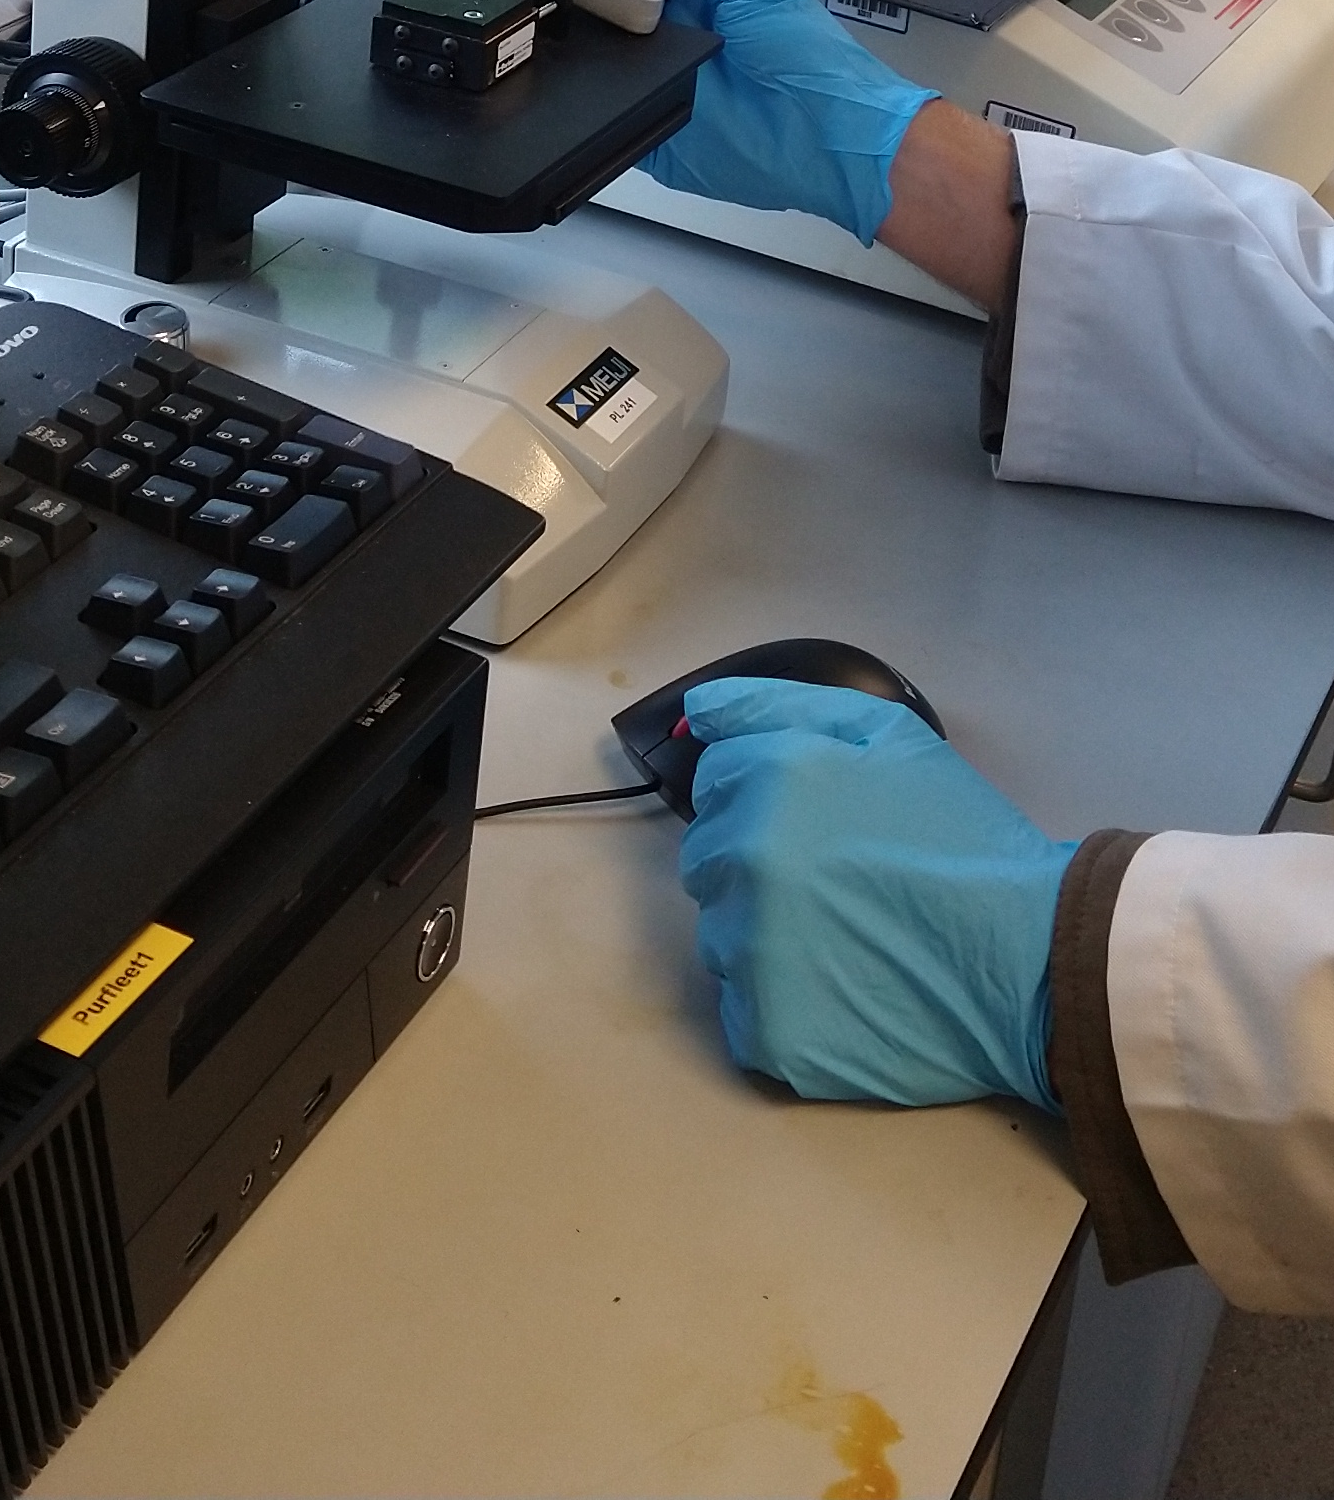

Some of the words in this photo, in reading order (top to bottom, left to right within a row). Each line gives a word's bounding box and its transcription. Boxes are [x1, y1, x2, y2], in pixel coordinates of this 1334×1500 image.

[586, 355, 633, 403] MEIJI
[608, 411, 624, 425] PL
[619, 396, 638, 415] 241
[71, 950, 155, 1027] Purfleet1
